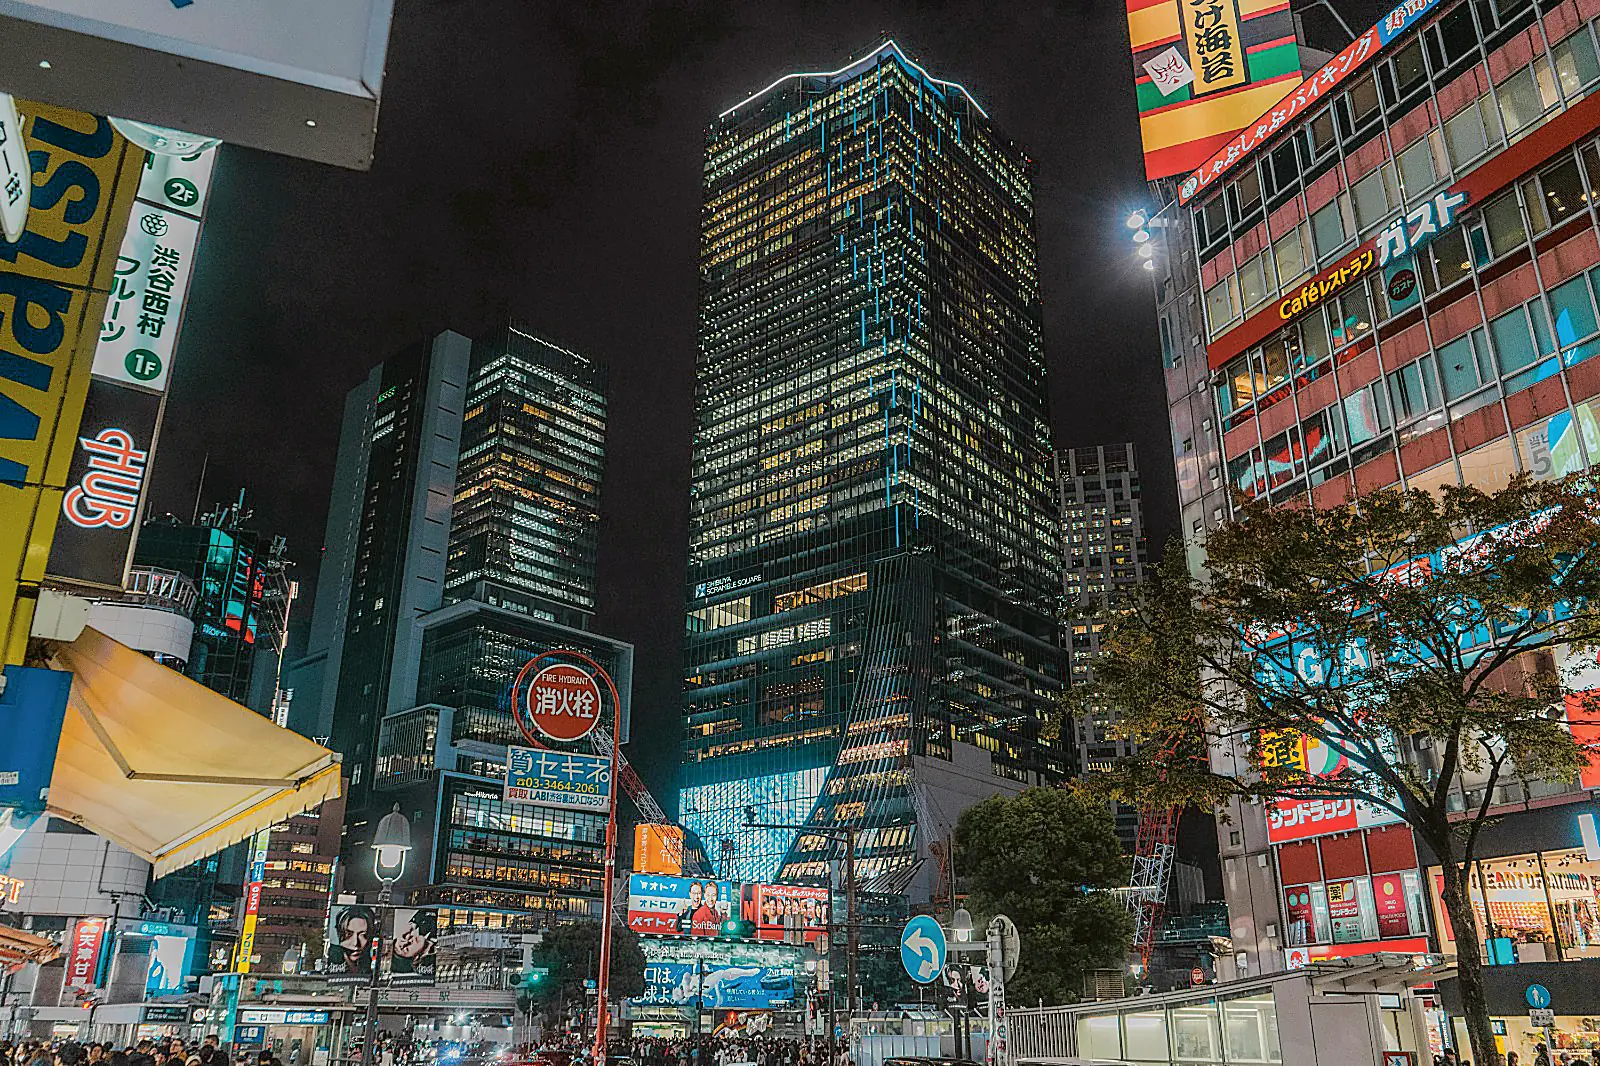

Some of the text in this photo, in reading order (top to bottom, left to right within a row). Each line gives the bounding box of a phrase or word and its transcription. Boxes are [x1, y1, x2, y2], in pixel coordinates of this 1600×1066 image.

[1198, 29, 1374, 185] しゃぶしゃぶバイキング
[170, 182, 195, 203] 2F
[1376, 191, 1466, 267] ガスト
[137, 244, 181, 339] 渋谷西村
[133, 352, 157, 377] 1F
[63, 427, 148, 530] HUB
[707, 576, 731, 588] SHIBUYA
[707, 574, 762, 596] SCRAMBLE SQUARE
[541, 673, 589, 686] FIRE HYDRANT
[535, 686, 595, 719] 消火栓
[525, 777, 600, 795] 03-3464-2061
[1270, 799, 1353, 830] サンドラッグ
[639, 899, 677, 910] オドロク
